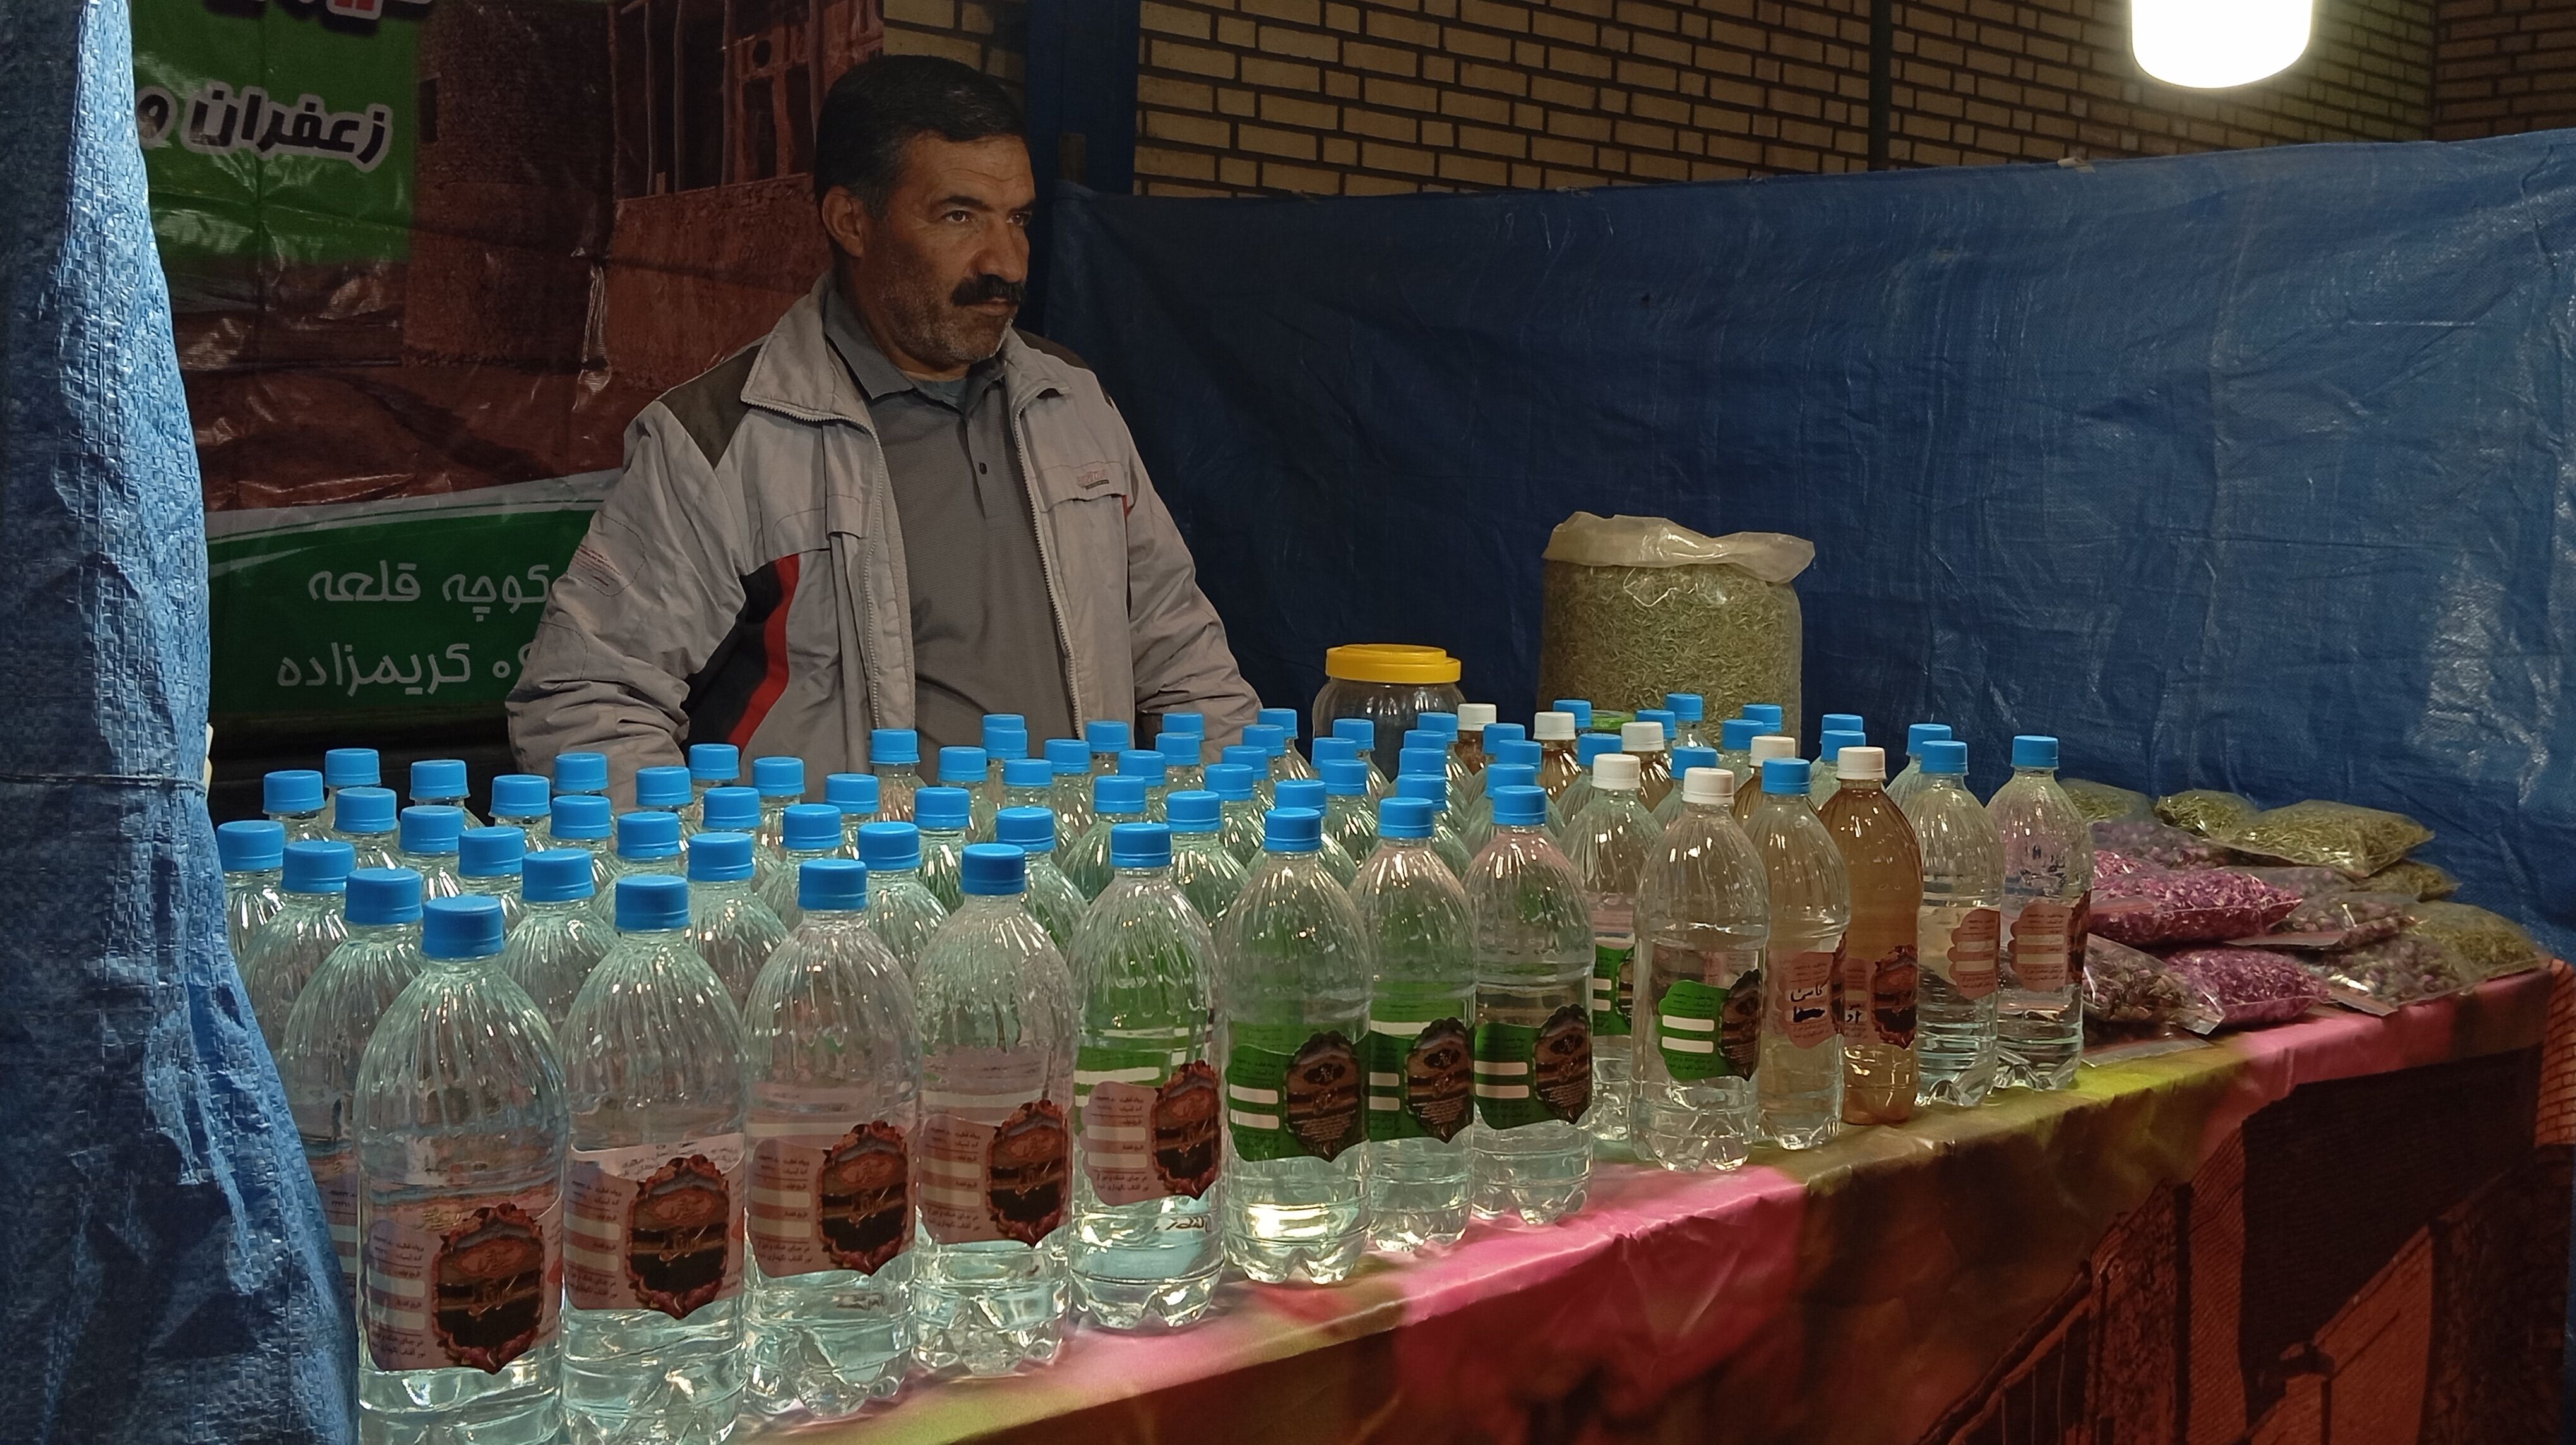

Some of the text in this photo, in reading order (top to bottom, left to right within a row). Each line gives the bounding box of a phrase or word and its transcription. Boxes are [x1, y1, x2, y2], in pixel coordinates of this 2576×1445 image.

[185, 85, 389, 168] زعفران
[308, 560, 421, 601] قلعه
[442, 564, 550, 622] کوچه
[277, 642, 471, 696] کریمزاده
